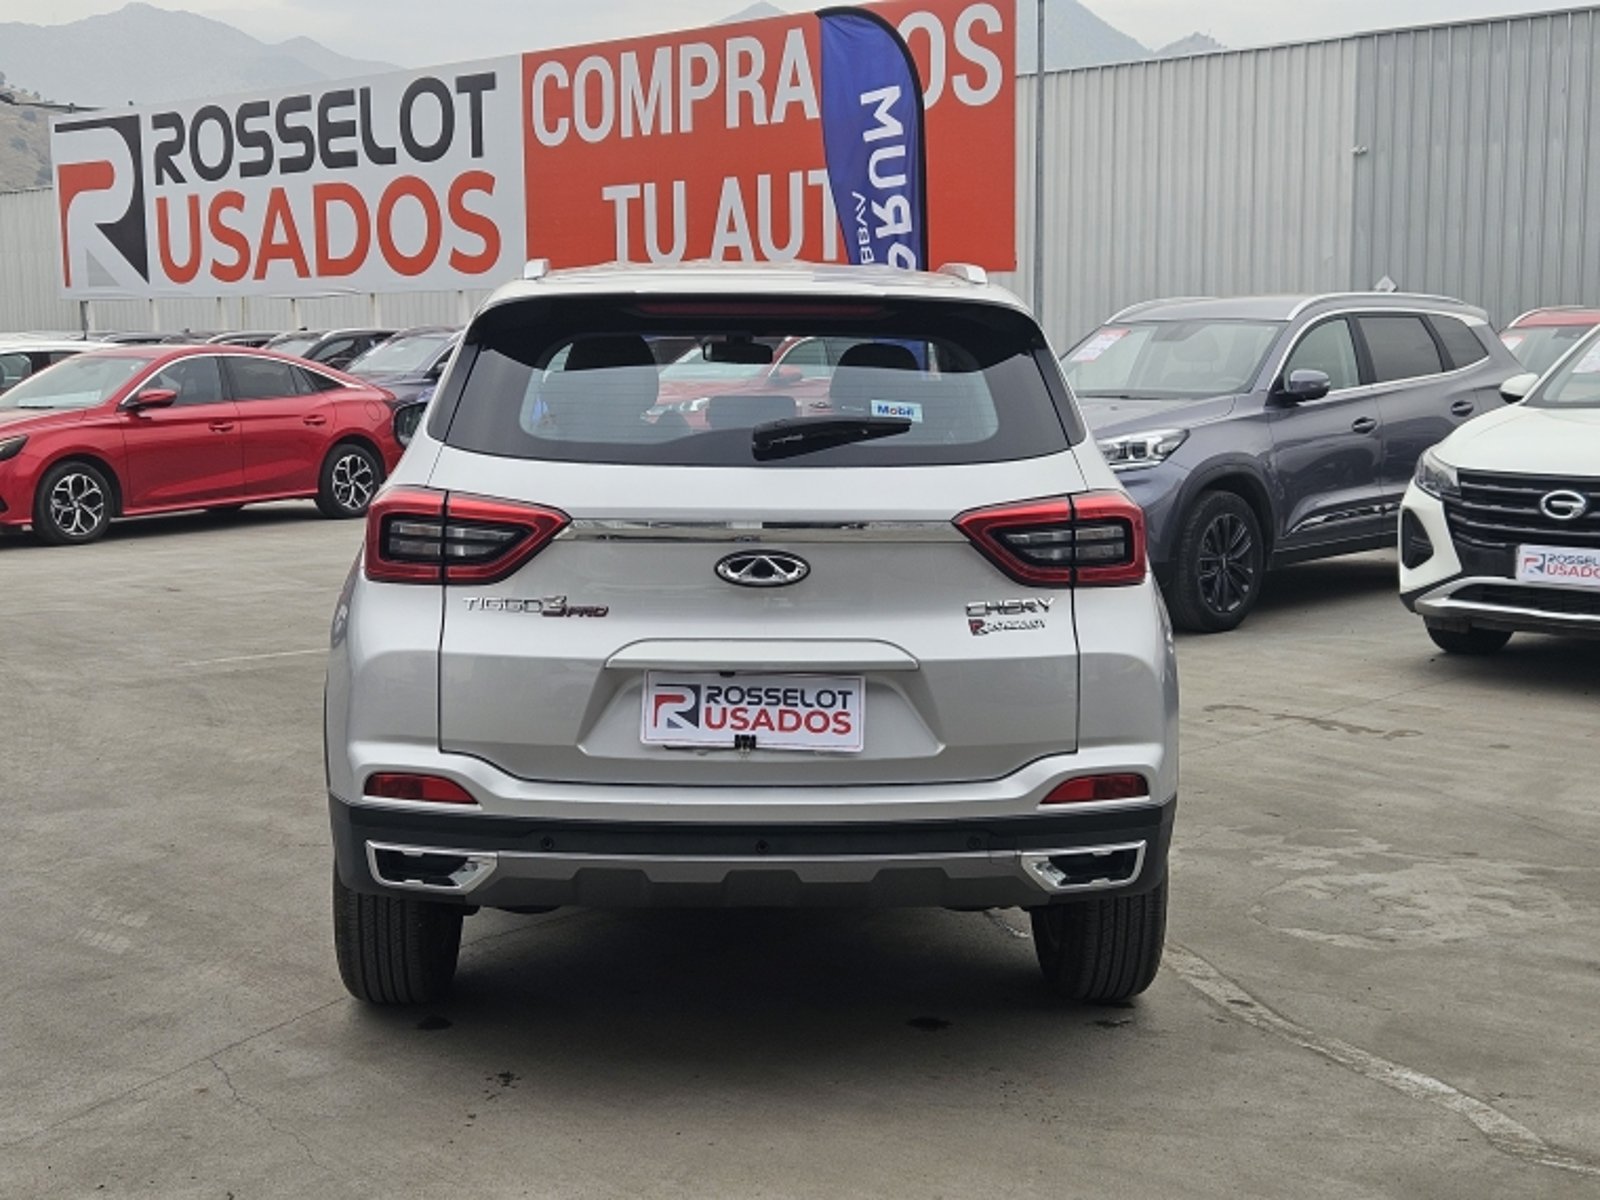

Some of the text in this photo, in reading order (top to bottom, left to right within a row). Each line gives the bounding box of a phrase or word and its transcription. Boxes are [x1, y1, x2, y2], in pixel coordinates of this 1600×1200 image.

[531, 2, 1003, 147] COMPRAOS
[152, 71, 497, 187] ROSSELOT
[155, 170, 501, 285] USADOS
[602, 168, 838, 264] TU AUT
[877, 405, 914, 416] Mobil
[966, 598, 1055, 617] CHERY
[704, 706, 853, 735] USADOS
[705, 685, 853, 709] ROSSELOT
